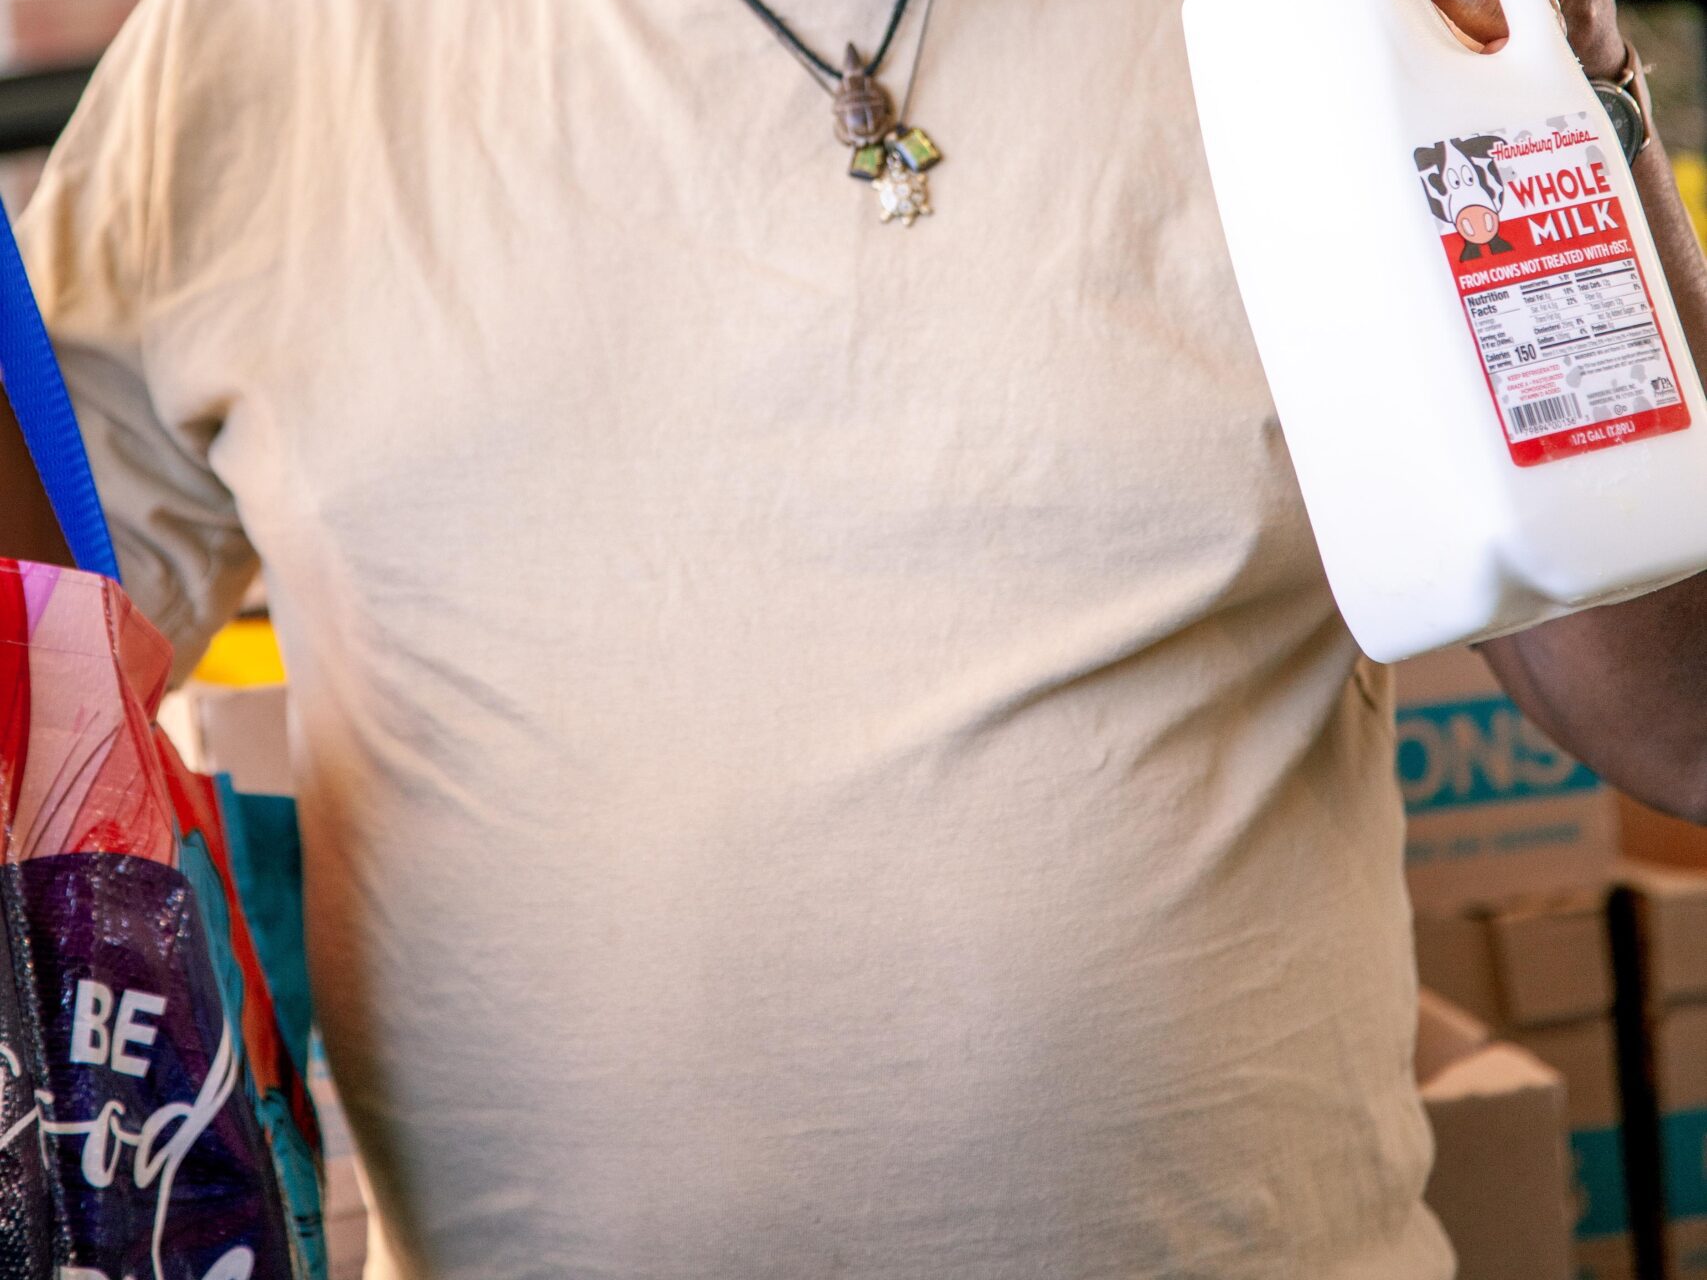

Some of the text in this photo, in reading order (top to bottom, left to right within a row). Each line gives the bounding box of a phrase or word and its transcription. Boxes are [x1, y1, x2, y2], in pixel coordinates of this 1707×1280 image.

[1492, 129, 1598, 160] Harrisburg Dairies
[1508, 162, 1611, 209] WHOLE
[1528, 201, 1618, 245] MILK
[1459, 271, 1490, 290] FROM
[1490, 265, 1521, 284] COWS
[1519, 259, 1541, 276] NOT
[1540, 249, 1584, 271] TREATED
[1585, 243, 1613, 261] WITH
[1467, 290, 1509, 307] Nutrition
[1471, 304, 1498, 318] Facts
[1515, 343, 1536, 362] 150
[1660, 377, 1674, 389] PA
[1571, 432, 1588, 446] 1/2
[1587, 426, 1606, 442] GAL
[69, 979, 168, 1078] BE
